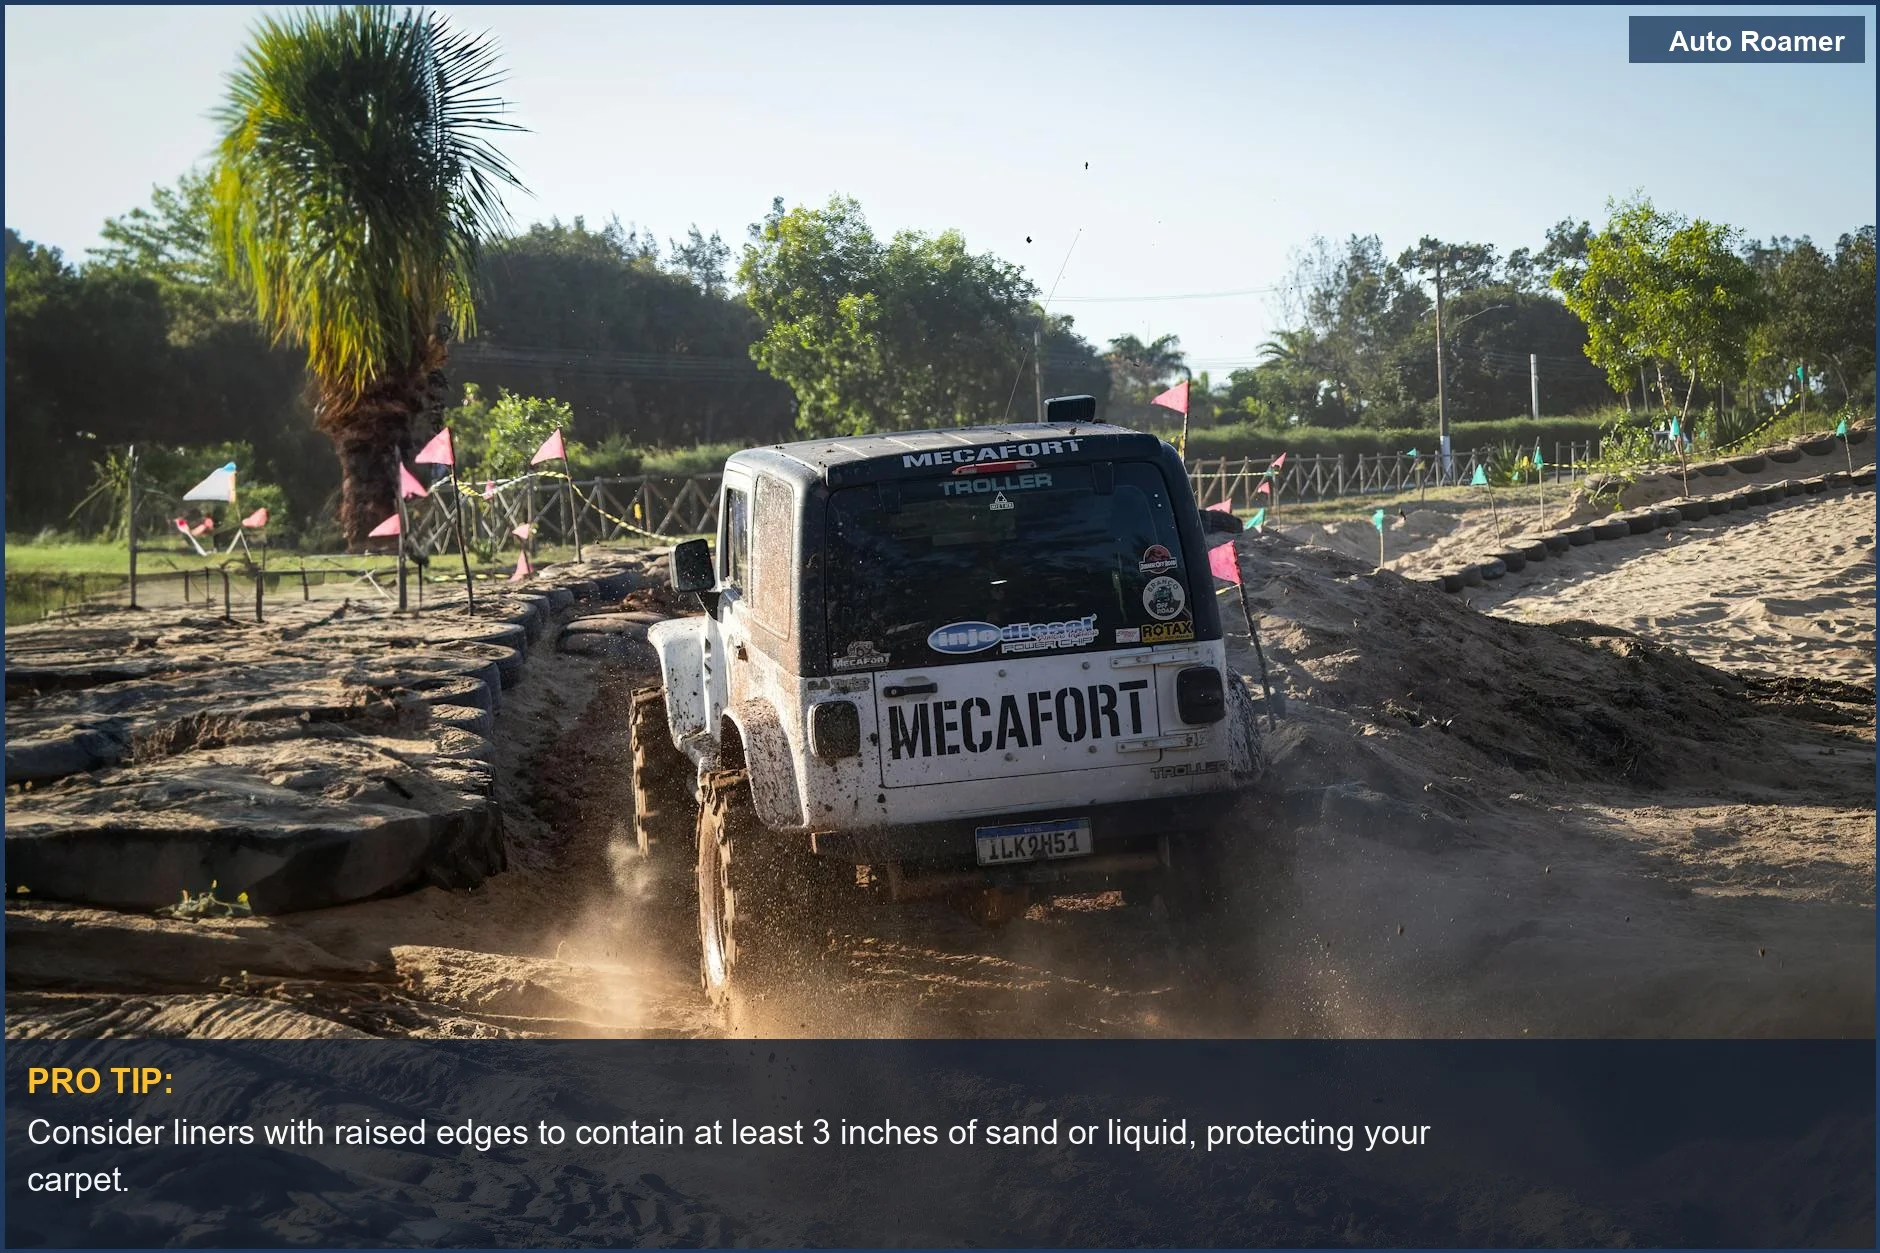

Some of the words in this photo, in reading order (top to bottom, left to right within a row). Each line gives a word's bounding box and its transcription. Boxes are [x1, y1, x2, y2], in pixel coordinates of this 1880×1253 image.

[903, 438, 1084, 468] MECAFORT
[938, 473, 1053, 496] TROLLER
[1142, 621, 1193, 637] ROTAX
[1002, 640, 1055, 652] POWER
[1060, 637, 1093, 647] CHIP
[888, 680, 1148, 760] MECAFORT
[1151, 760, 1230, 779] TROLLER
